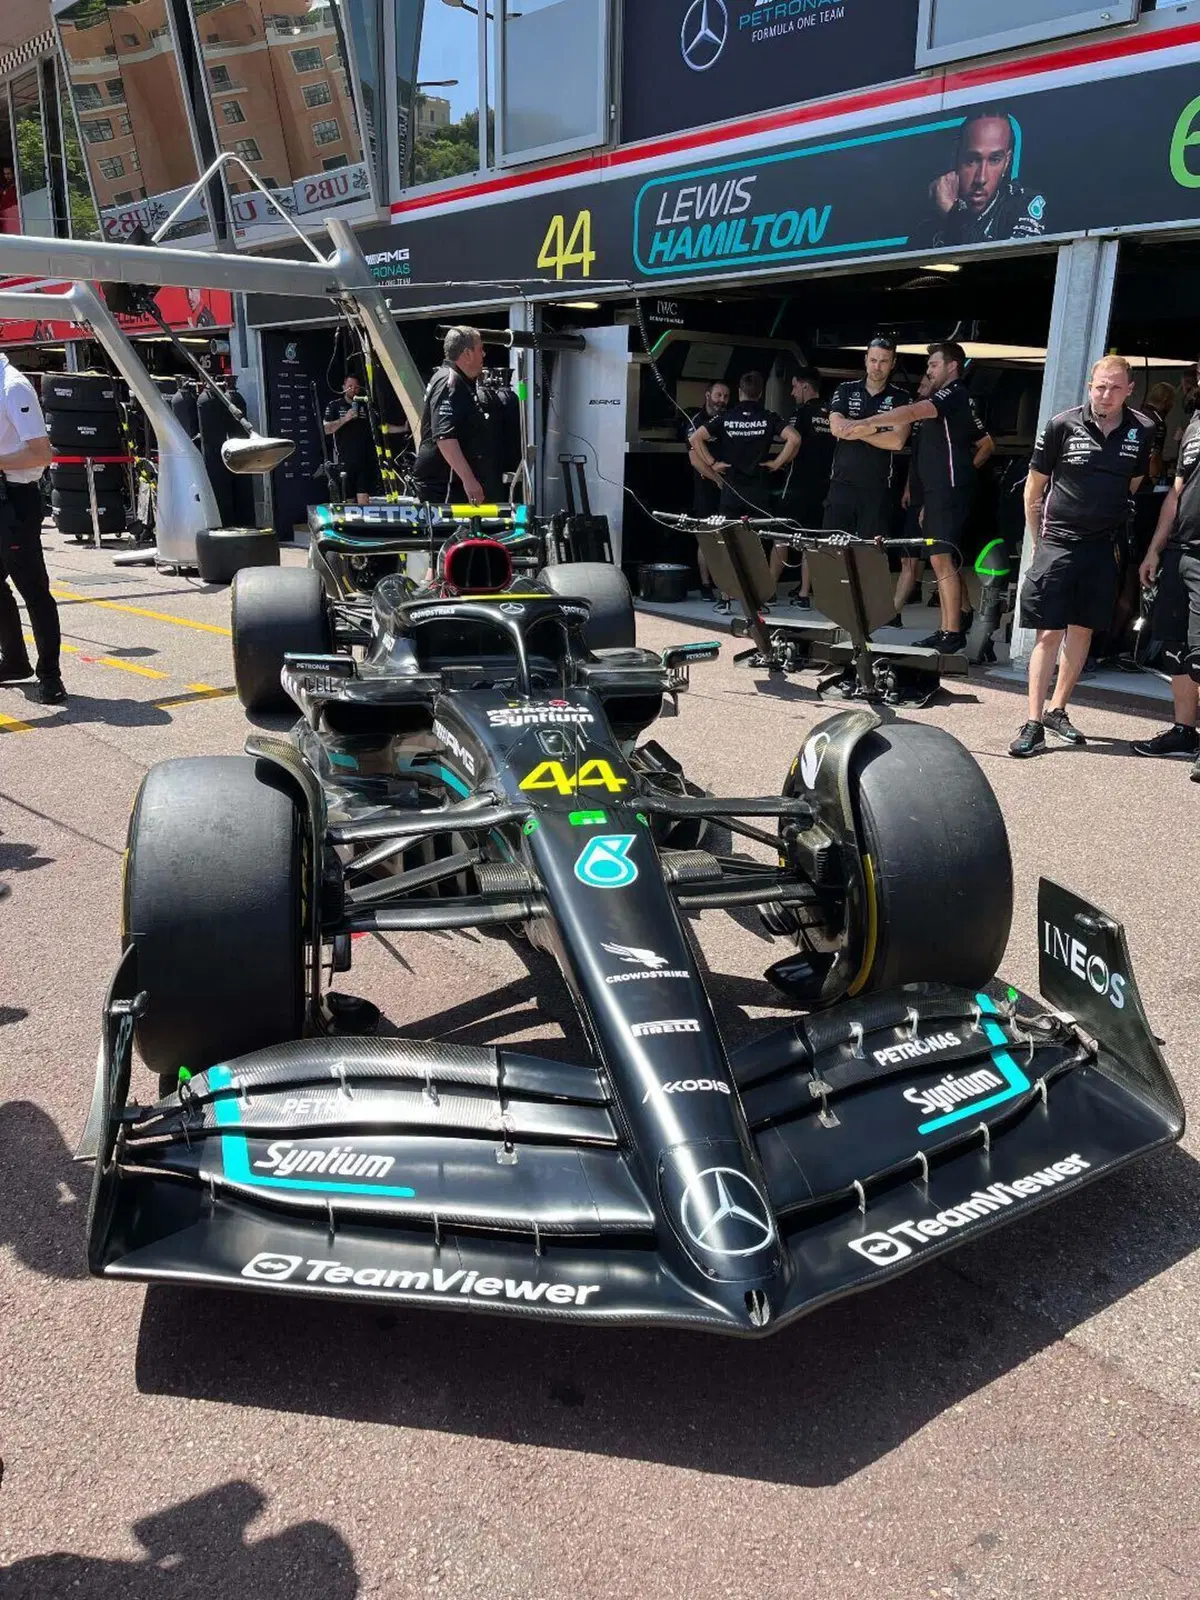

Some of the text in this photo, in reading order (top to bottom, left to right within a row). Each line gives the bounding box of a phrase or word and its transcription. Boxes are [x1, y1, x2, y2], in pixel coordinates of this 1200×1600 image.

[739, 0, 846, 30] PETRONA
[751, 6, 846, 43] FORMULA ONE TEAM
[655, 175, 758, 226] LEWIS
[537, 209, 597, 280] 44
[648, 204, 833, 264] HAMILTON
[376, 248, 410, 263] AMG
[724, 420, 768, 429] PETRONAS
[344, 505, 444, 525] PETRO
[296, 662, 330, 671] PETRONAS
[489, 711, 595, 727] Syntium
[518, 759, 629, 796] 44
[605, 970, 691, 984] CROWDSTRIKE
[1043, 920, 1127, 1009] INEOS
[631, 1019, 701, 1038] PIRELLI
[872, 1031, 962, 1066] PETRONAS
[902, 1068, 1004, 1115] Syntium
[253, 1141, 397, 1178] Syntium
[887, 1152, 1092, 1244] TeamViewer
[304, 1258, 601, 1306] TeamViewer
